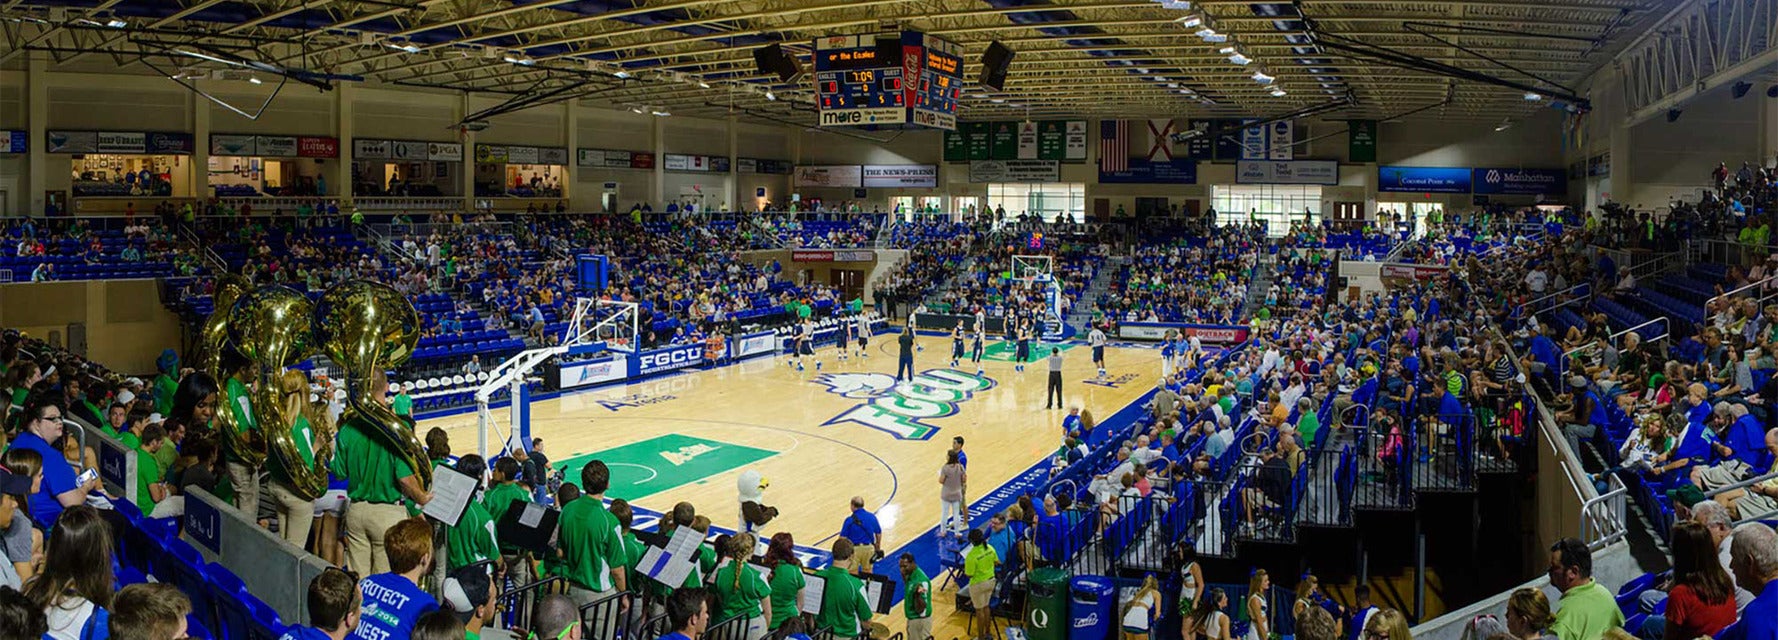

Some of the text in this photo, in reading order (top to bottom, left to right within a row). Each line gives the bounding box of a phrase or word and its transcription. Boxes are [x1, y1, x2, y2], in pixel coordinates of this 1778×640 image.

[853, 51, 876, 60] Eagles
[904, 54, 918, 92] Coca-Cola
[823, 111, 861, 124] more
[439, 146, 458, 154] PGA
[1401, 177, 1427, 185] Coconut
[1503, 172, 1554, 183] Manhattan
[640, 347, 703, 370] FGCU
[377, 612, 400, 627] 2014
[1031, 608, 1048, 629] Q
